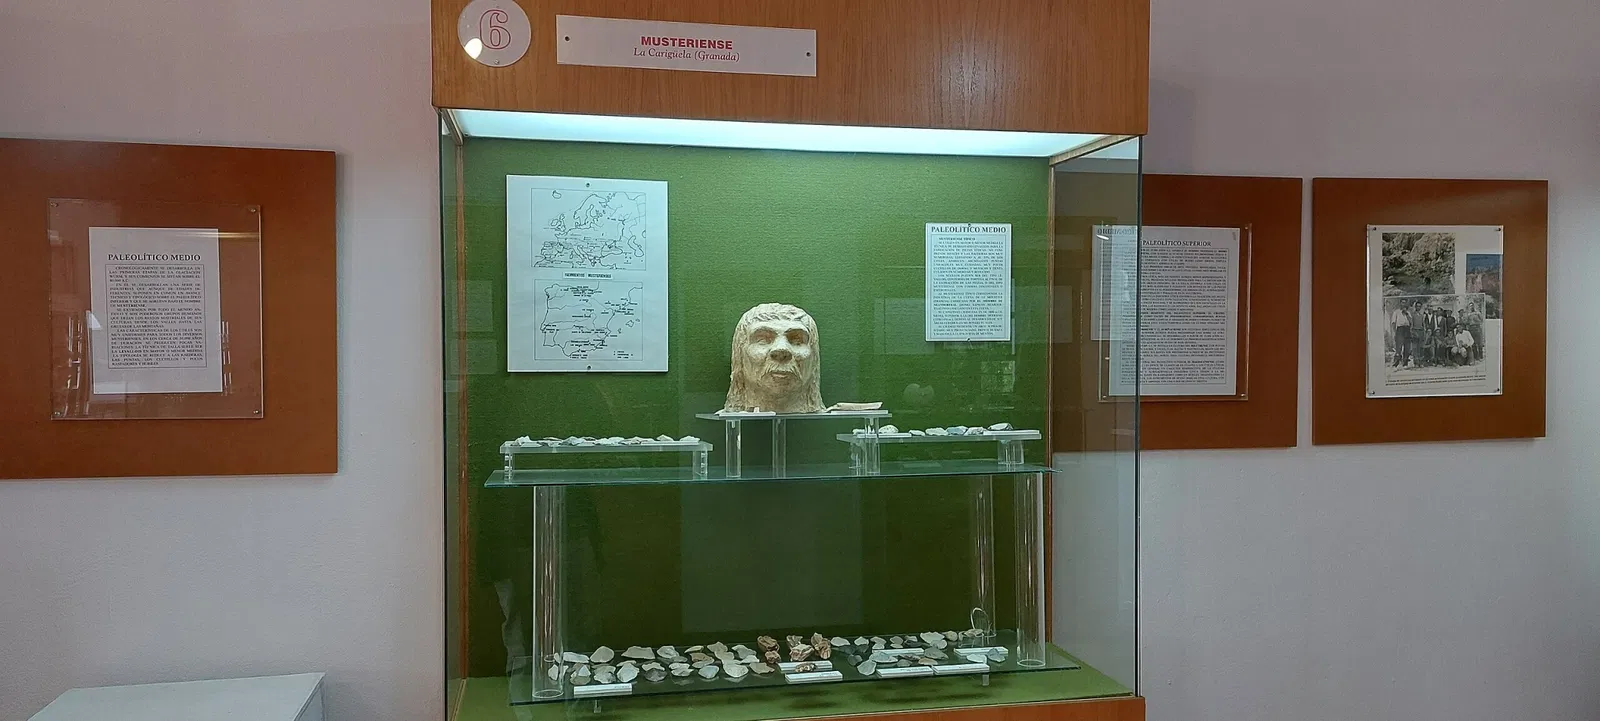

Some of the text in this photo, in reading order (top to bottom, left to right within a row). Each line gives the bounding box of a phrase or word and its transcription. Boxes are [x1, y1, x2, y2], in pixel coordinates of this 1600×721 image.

[479, 9, 511, 50] 6
[640, 36, 733, 50] MUSTERIENSE
[633, 47, 740, 62] La Carigüela (Granada)
[108, 253, 169, 261] PALEOLÍTICO
